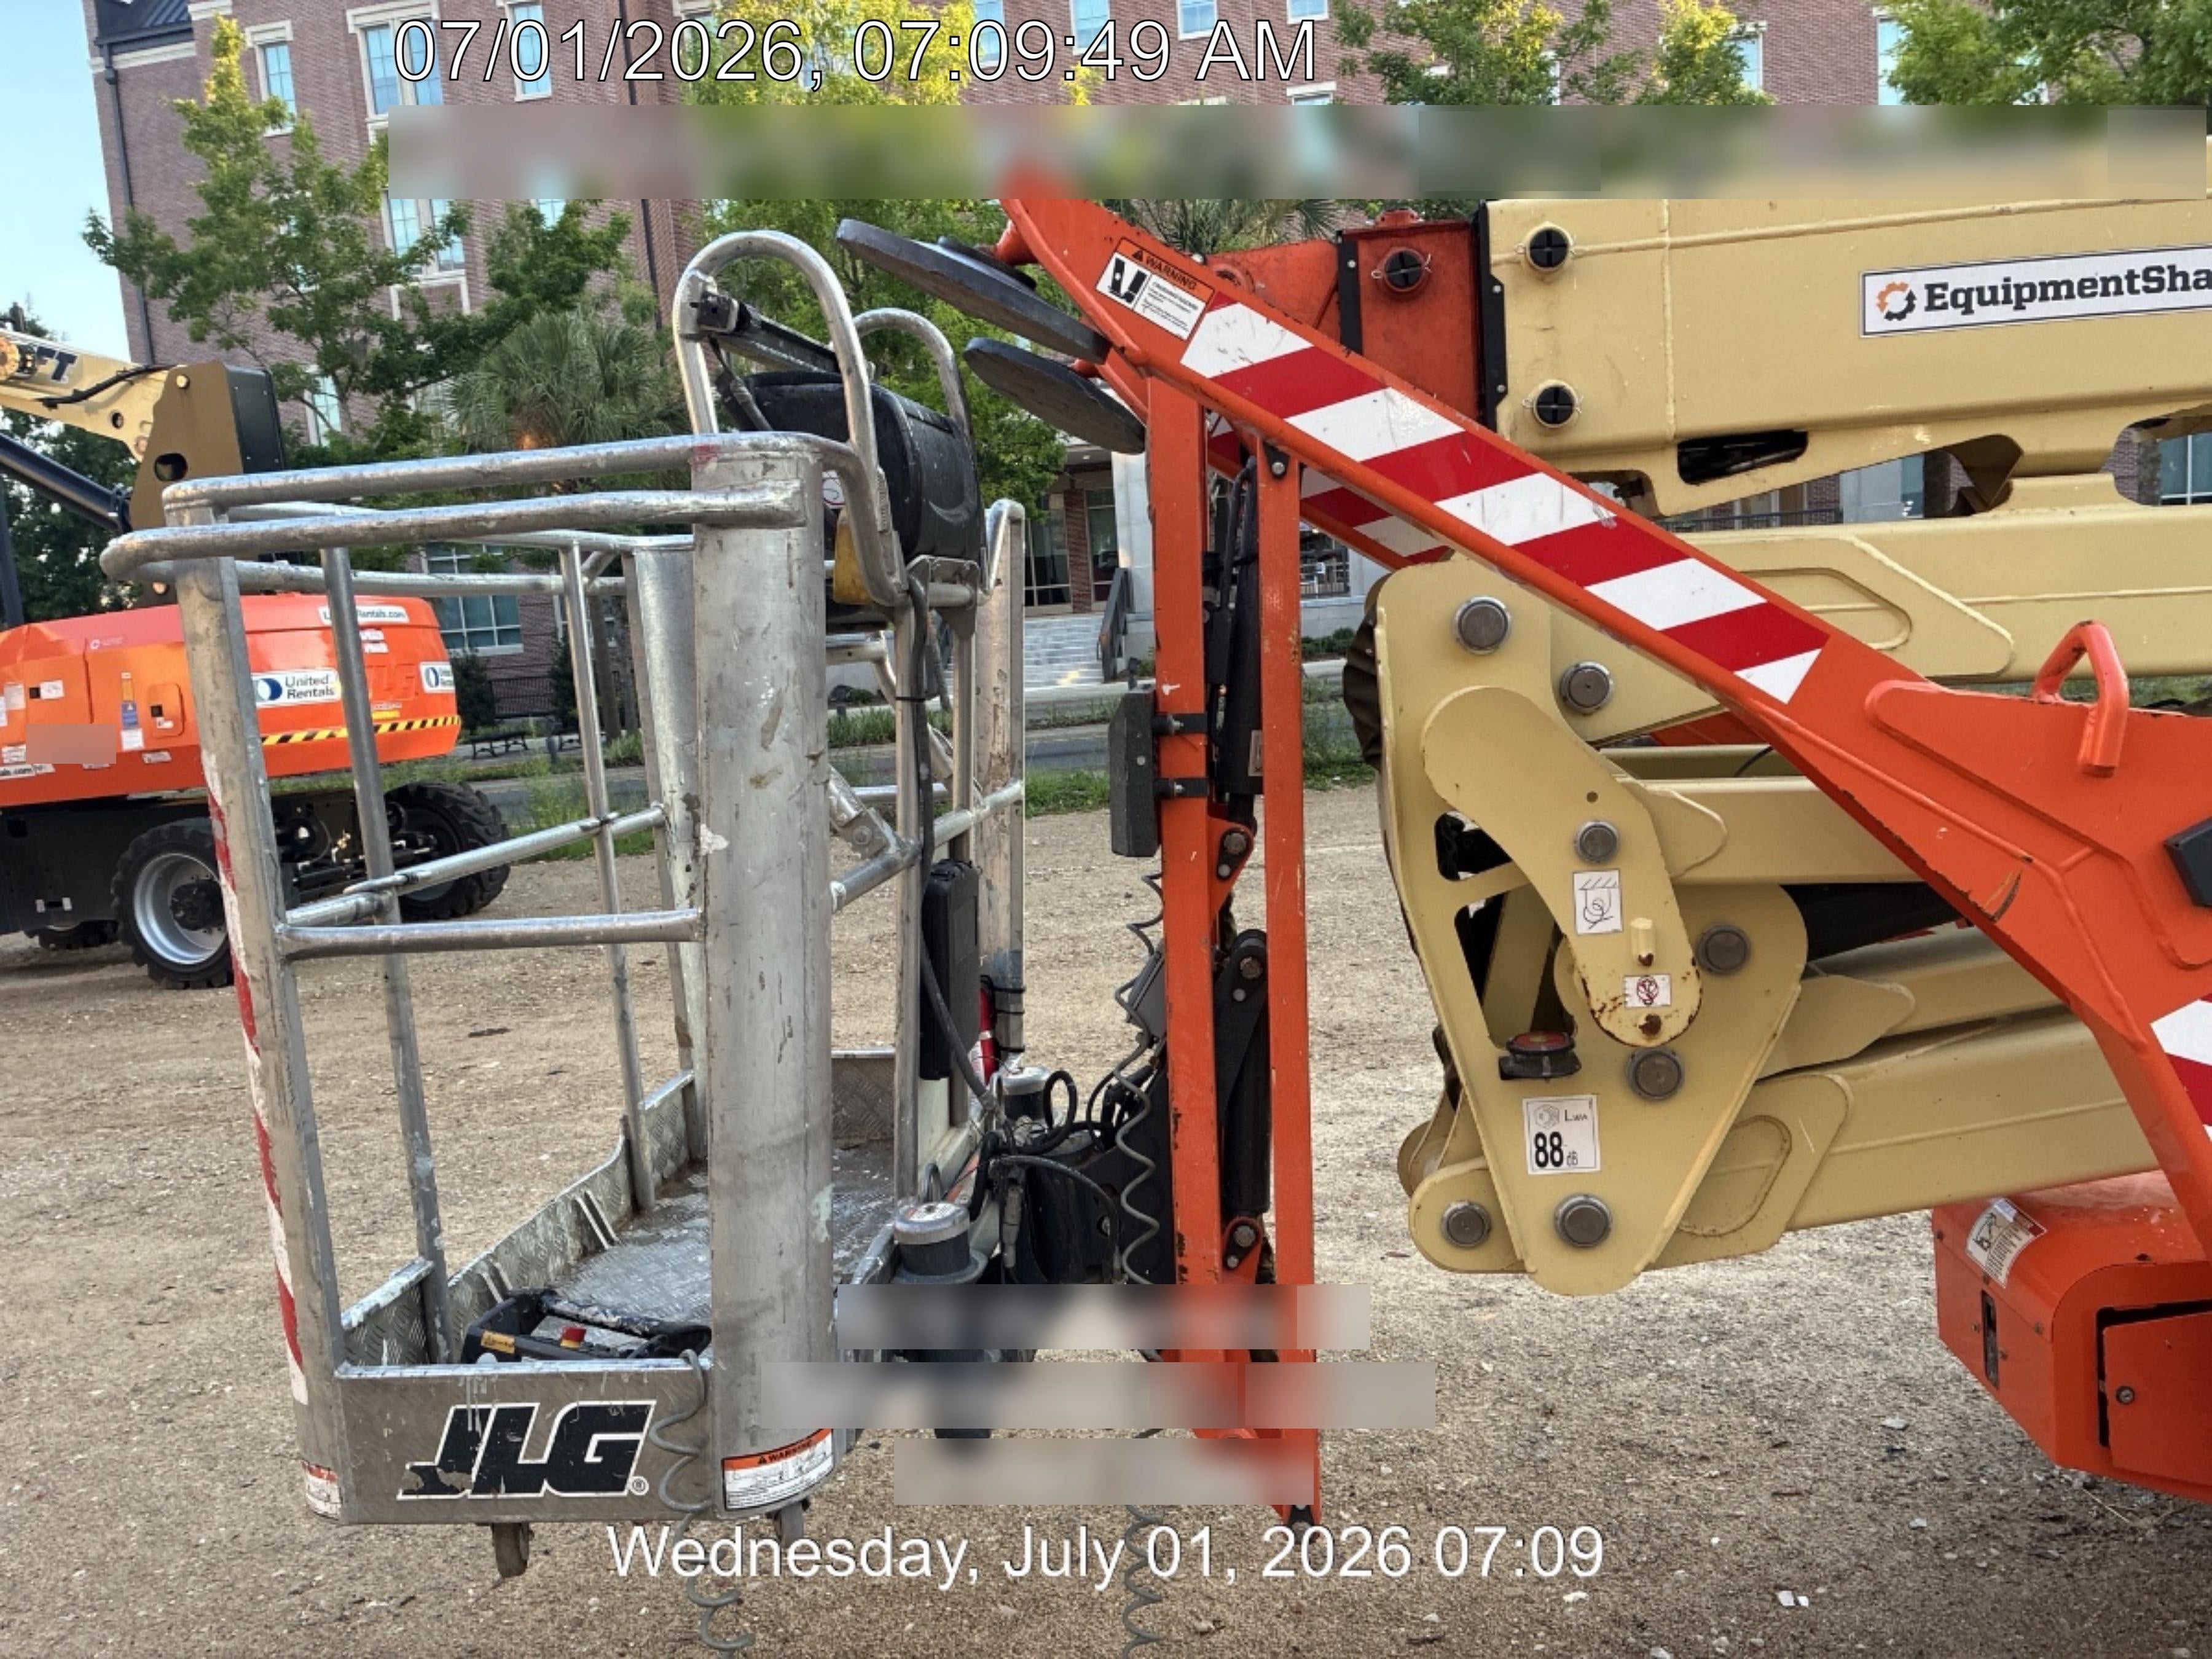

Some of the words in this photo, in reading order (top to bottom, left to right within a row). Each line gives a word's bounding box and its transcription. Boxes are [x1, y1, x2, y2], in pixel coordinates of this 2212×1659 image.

[1146, 256, 1198, 291] WARNING
[284, 673, 329, 689] United
[287, 685, 335, 700] Rentals
[1534, 1131, 1564, 1168] 88
[396, 1400, 657, 1500] JLG
